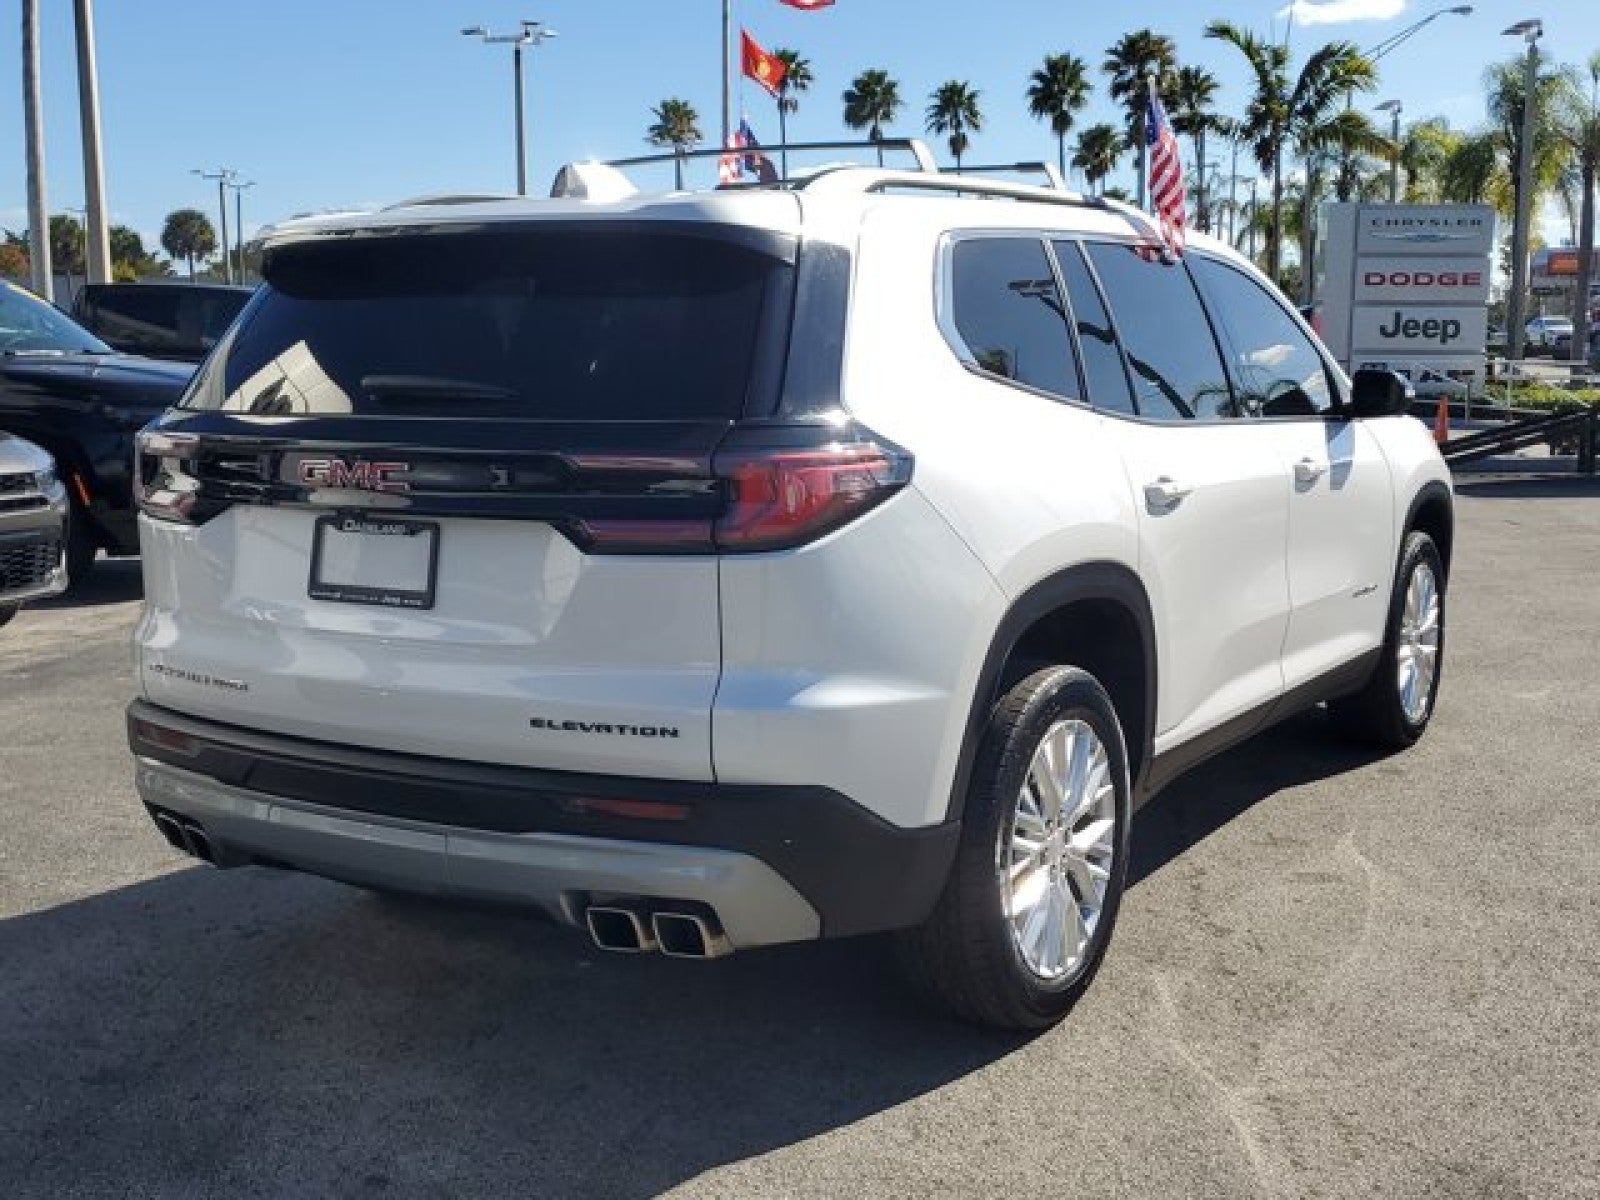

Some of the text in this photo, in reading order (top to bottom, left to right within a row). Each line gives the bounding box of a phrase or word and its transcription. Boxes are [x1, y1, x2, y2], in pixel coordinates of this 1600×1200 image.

[1370, 217, 1483, 227] CHRYSLER
[1364, 271, 1481, 286] DODGE
[1379, 311, 1461, 344] Jeep
[298, 458, 411, 492] GMC
[529, 717, 681, 738] ELEVATION
